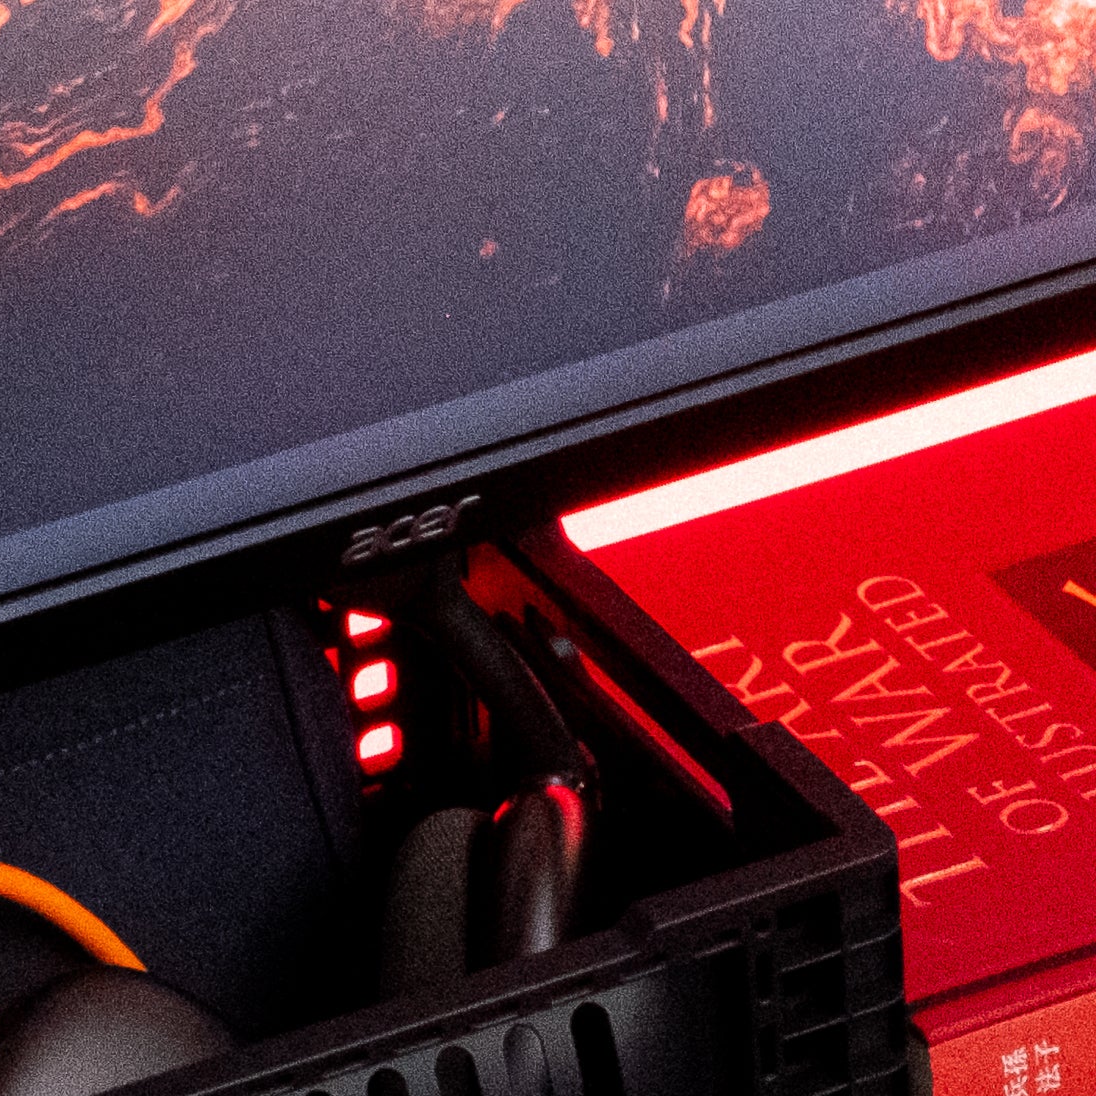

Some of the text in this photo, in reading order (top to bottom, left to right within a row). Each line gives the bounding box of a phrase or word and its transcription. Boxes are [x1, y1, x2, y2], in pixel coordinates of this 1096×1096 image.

[341, 494, 481, 565] acer
[783, 612, 1069, 835] OF WAR
